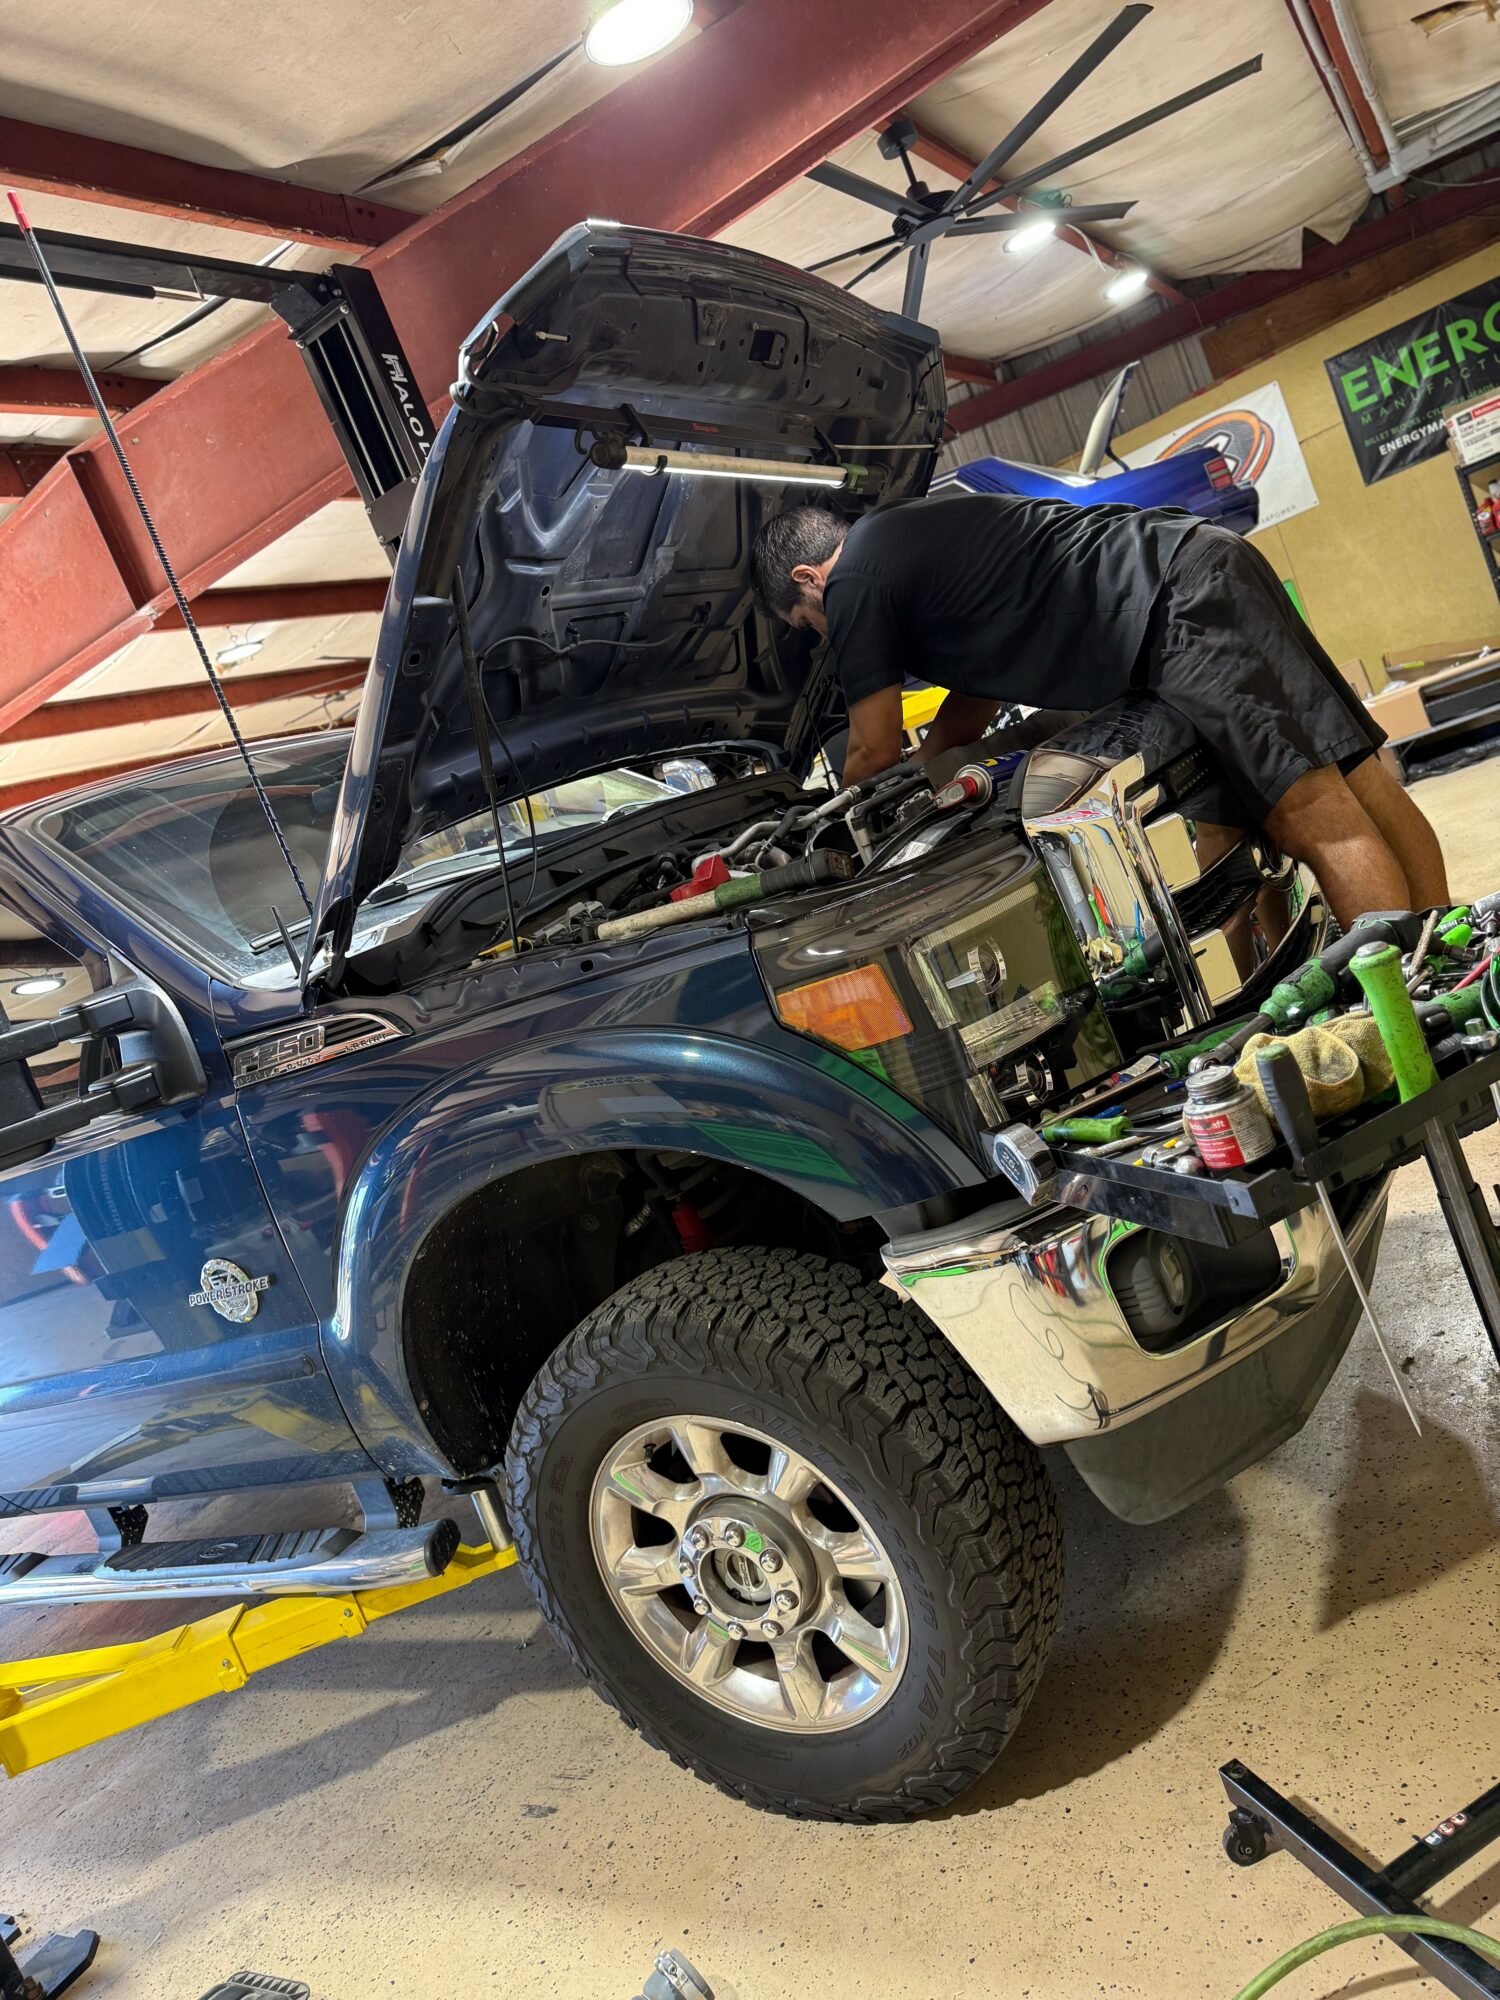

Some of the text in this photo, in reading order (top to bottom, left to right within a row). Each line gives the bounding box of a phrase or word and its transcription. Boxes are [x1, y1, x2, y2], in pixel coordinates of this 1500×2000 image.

[381, 353, 425, 438] HALO
[1364, 428, 1390, 447] BILLET
[1391, 416, 1421, 435] BLOCKS
[286, 1053, 323, 1071] DUTY
[345, 1033, 391, 1053] LARIAT
